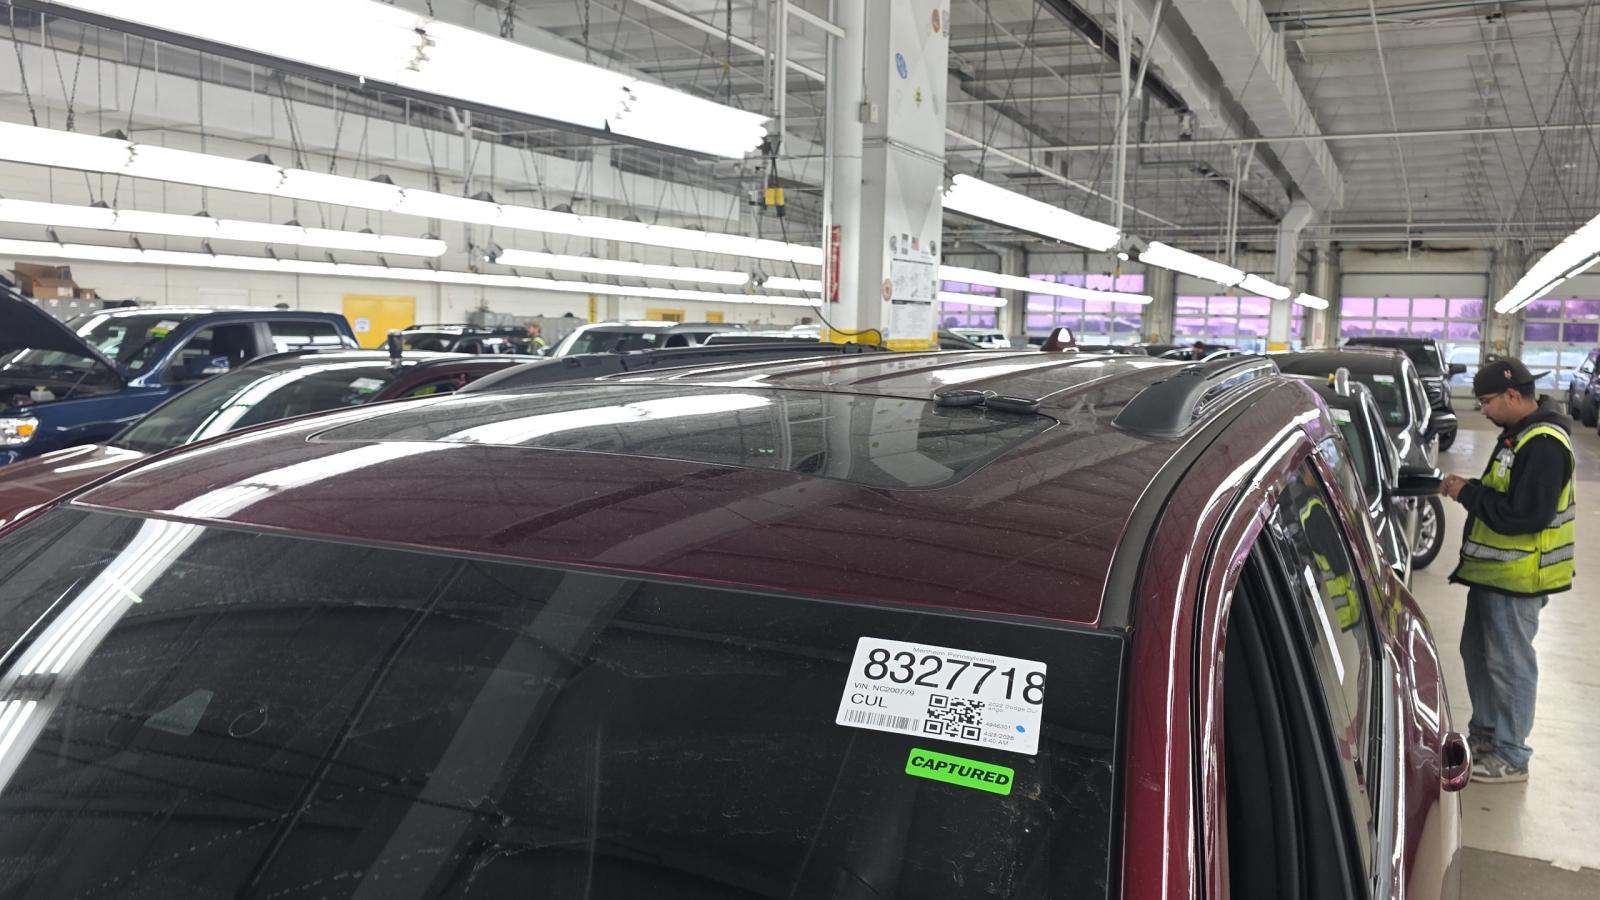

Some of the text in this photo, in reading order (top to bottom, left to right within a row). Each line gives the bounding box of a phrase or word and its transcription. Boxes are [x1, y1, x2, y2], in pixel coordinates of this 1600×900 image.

[912, 646, 996, 664] Manheim Pennsylvania
[864, 648, 1045, 705] 8327718
[851, 693, 888, 709] CUL
[911, 756, 1010, 786] CAPTURED
